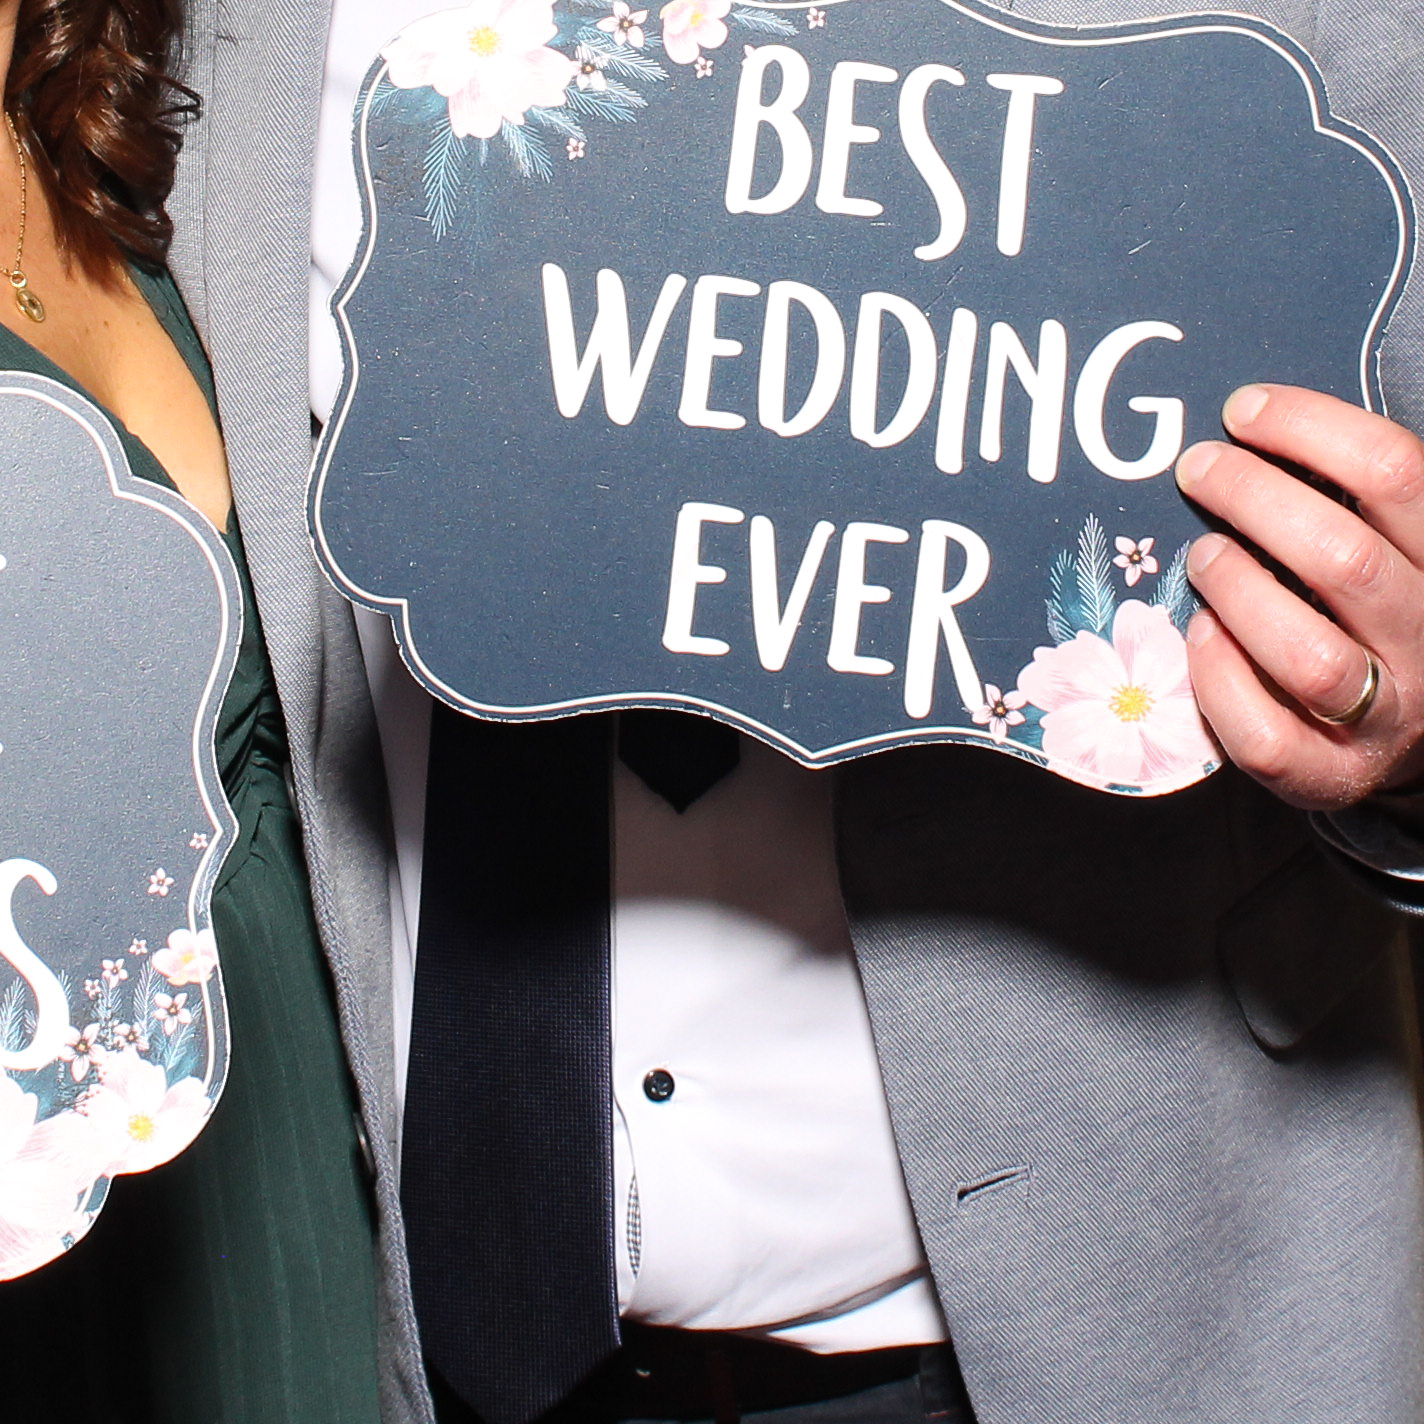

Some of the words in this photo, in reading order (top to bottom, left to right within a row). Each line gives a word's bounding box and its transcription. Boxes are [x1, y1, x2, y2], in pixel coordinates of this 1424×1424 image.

[726, 44, 1064, 260] BEST
[542, 262, 1184, 482] WEDDING
[662, 501, 991, 718] EVER
